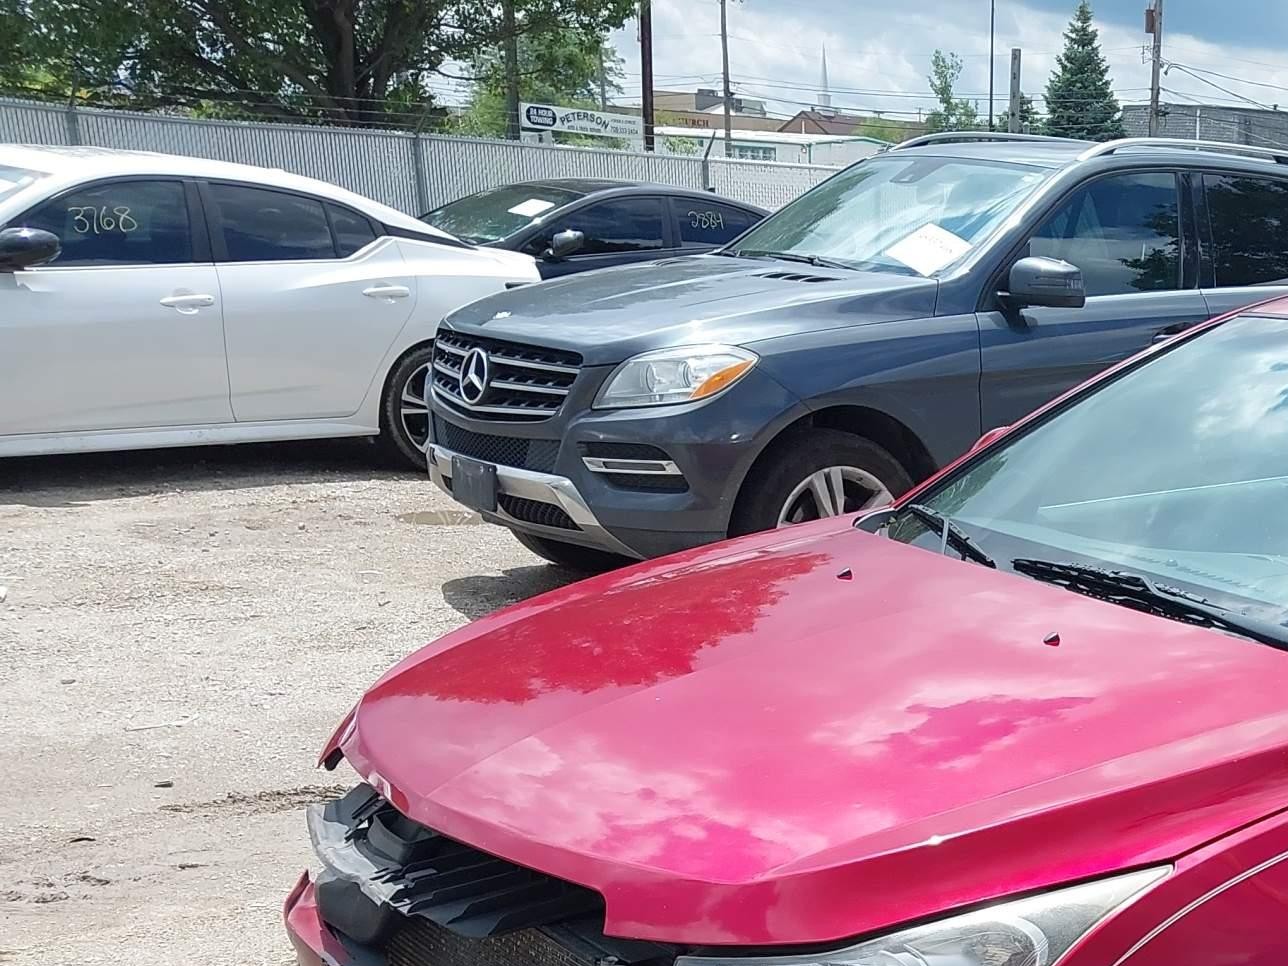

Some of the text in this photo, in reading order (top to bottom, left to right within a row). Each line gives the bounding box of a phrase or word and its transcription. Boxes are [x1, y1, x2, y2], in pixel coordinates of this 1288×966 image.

[530, 107, 553, 118] 24 HOUR
[530, 115, 553, 126] TOWING
[560, 111, 610, 129] PETERSON
[67, 206, 138, 234] 3768
